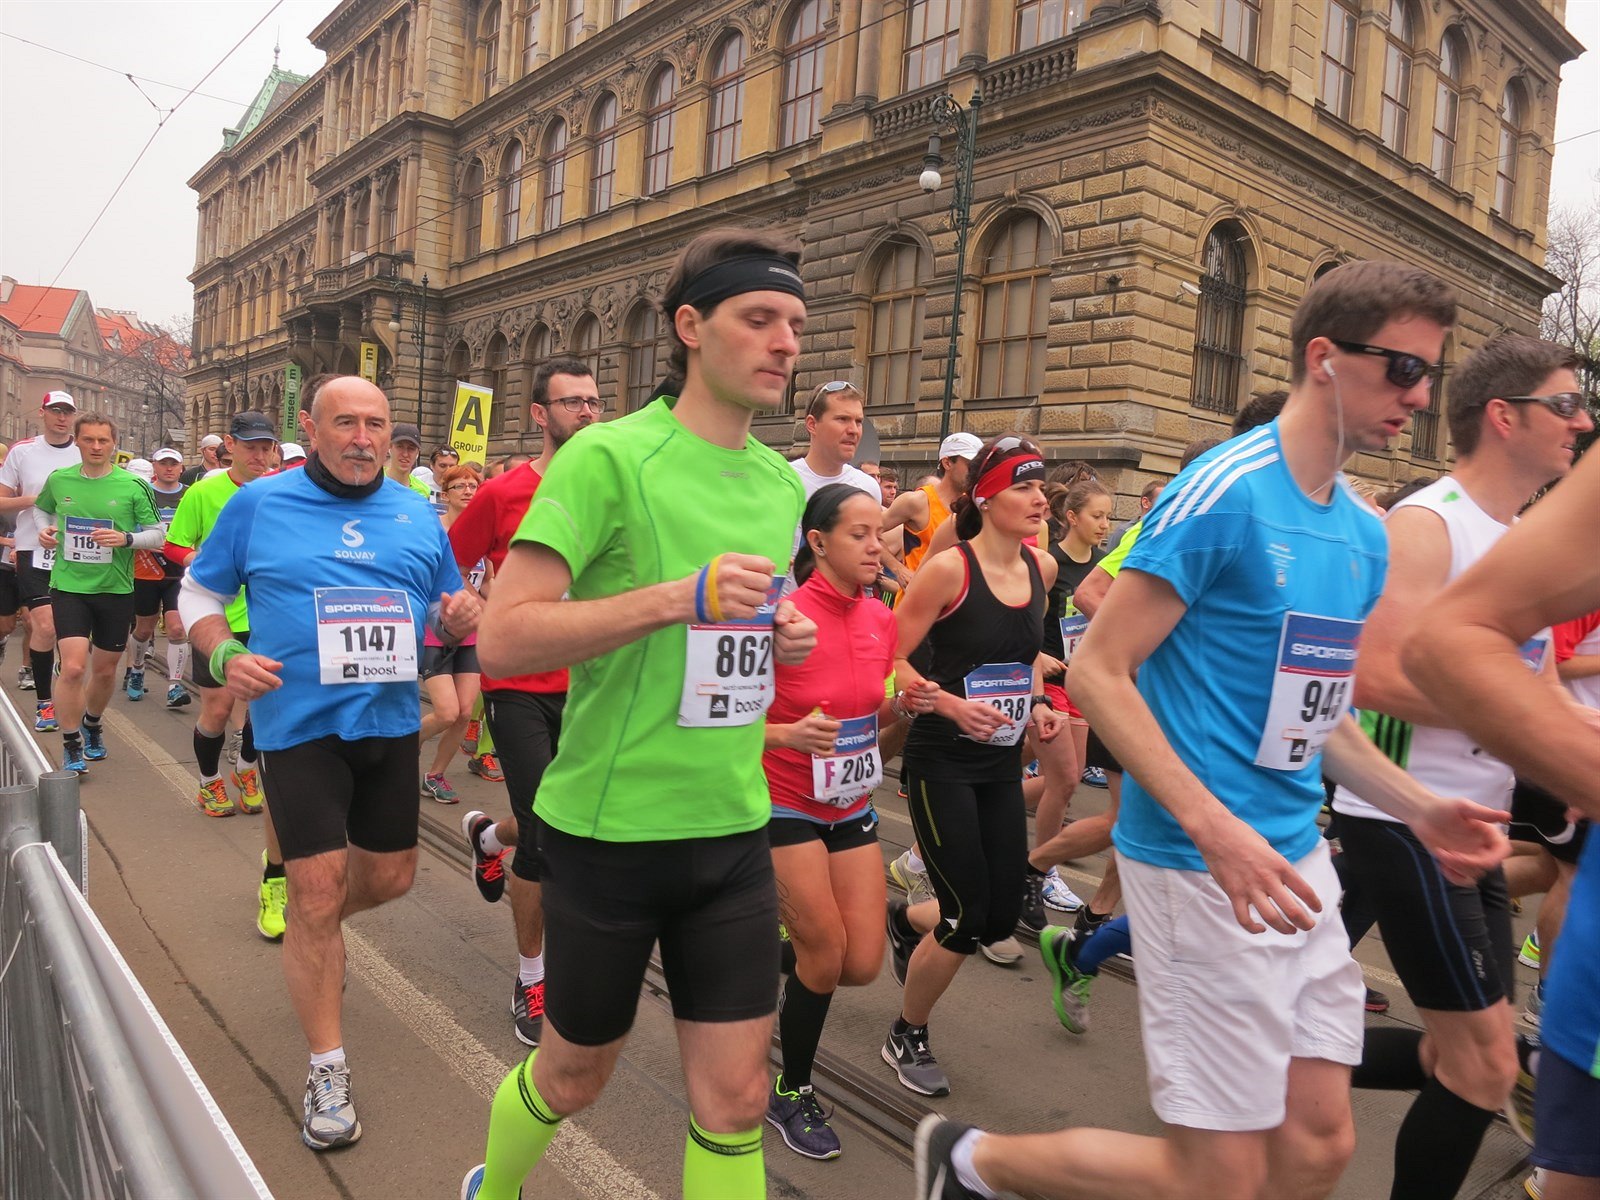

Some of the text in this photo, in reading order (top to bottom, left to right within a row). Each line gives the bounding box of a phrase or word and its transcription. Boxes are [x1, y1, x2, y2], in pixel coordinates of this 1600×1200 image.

[456, 395, 485, 436] A
[453, 440, 484, 453] GROUP
[334, 550, 376, 560] SOLVAY
[339, 625, 396, 652] 1147
[716, 634, 771, 678] 862
[363, 665, 397, 675] boost
[824, 752, 876, 788] F 203
